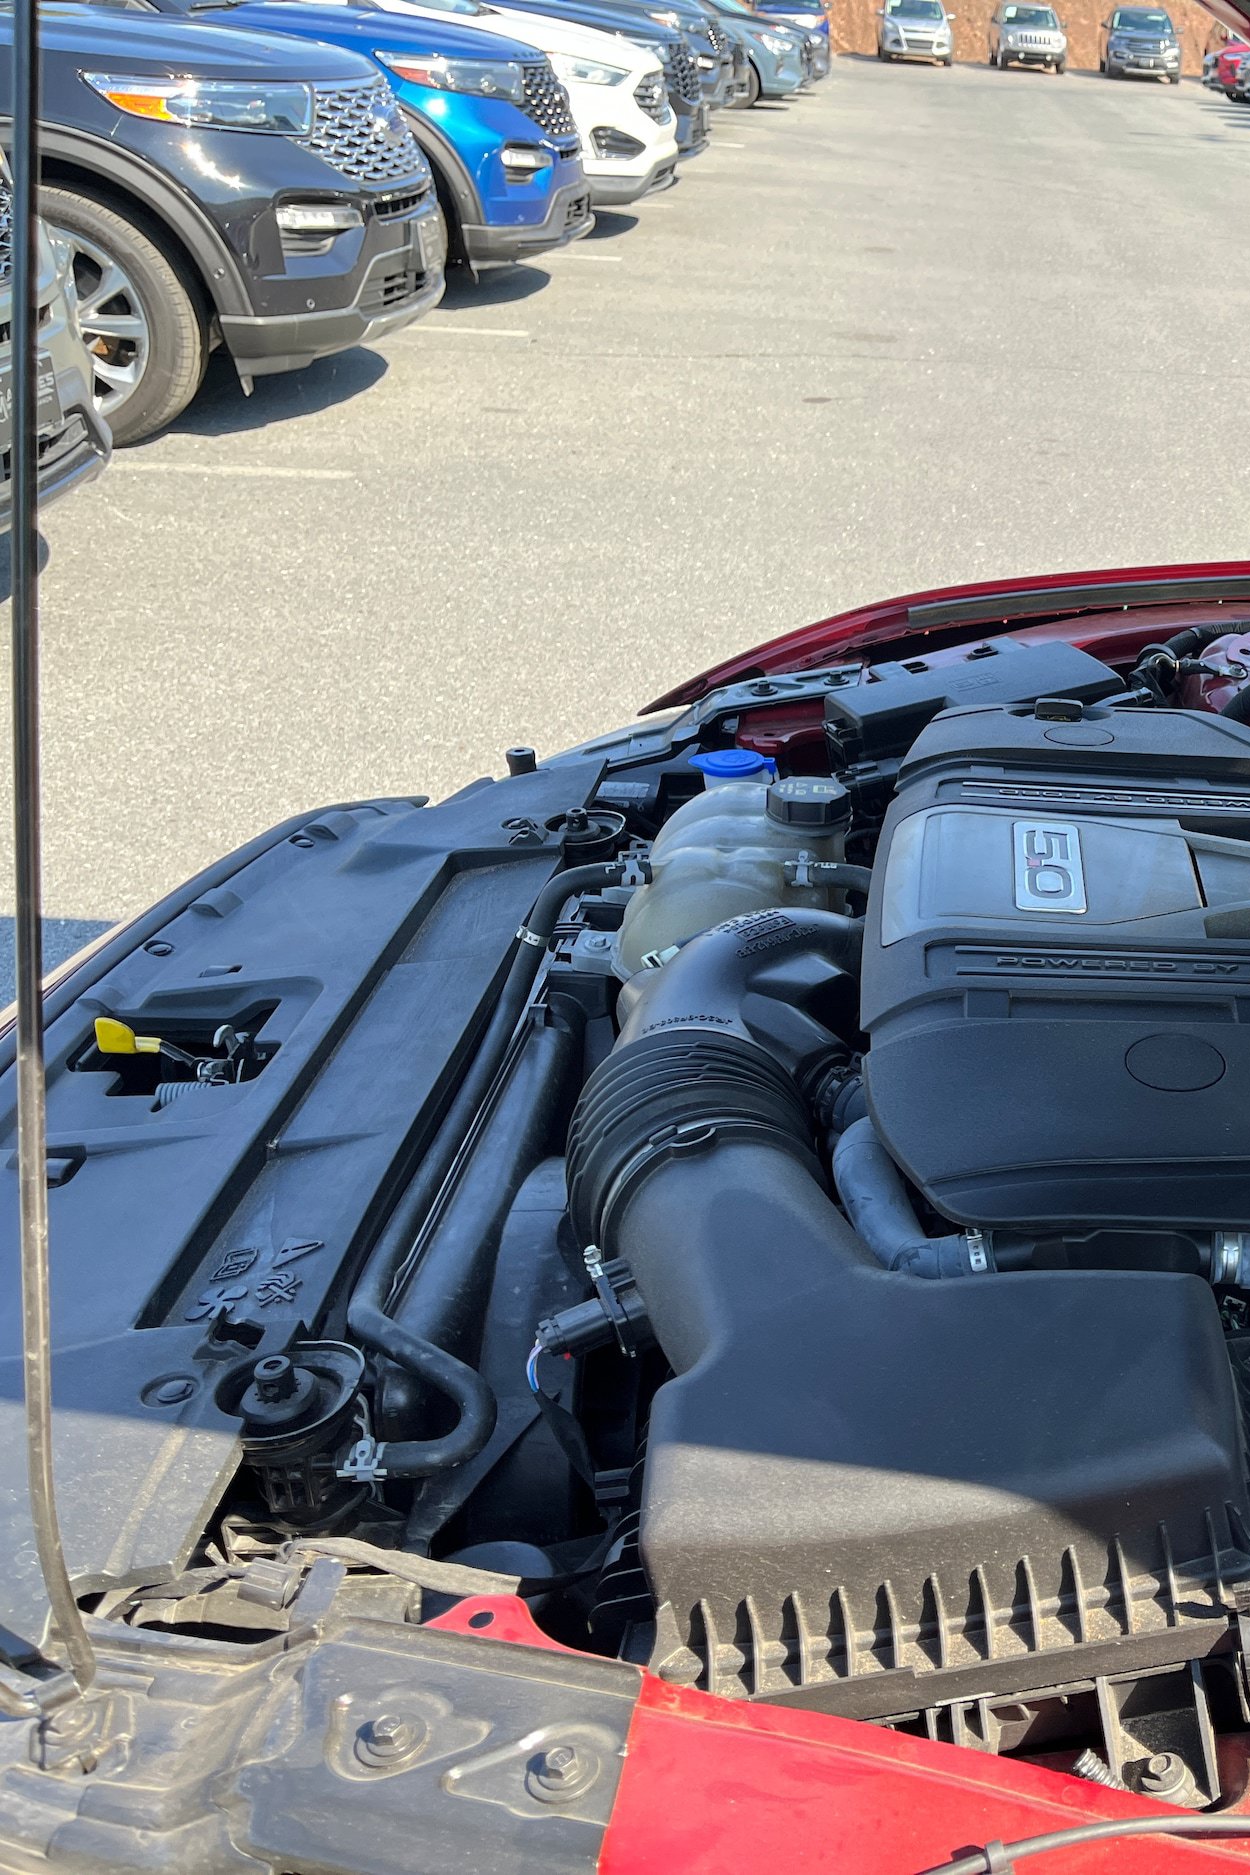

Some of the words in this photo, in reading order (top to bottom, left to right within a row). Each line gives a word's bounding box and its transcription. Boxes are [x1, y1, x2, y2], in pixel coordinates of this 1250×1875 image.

[999, 787, 1081, 799] FORD
[1096, 794, 1133, 803] BY
[1024, 830, 1074, 899] 5.0
[996, 955, 1177, 972] POWERED
[1192, 962, 1240, 974] BY
